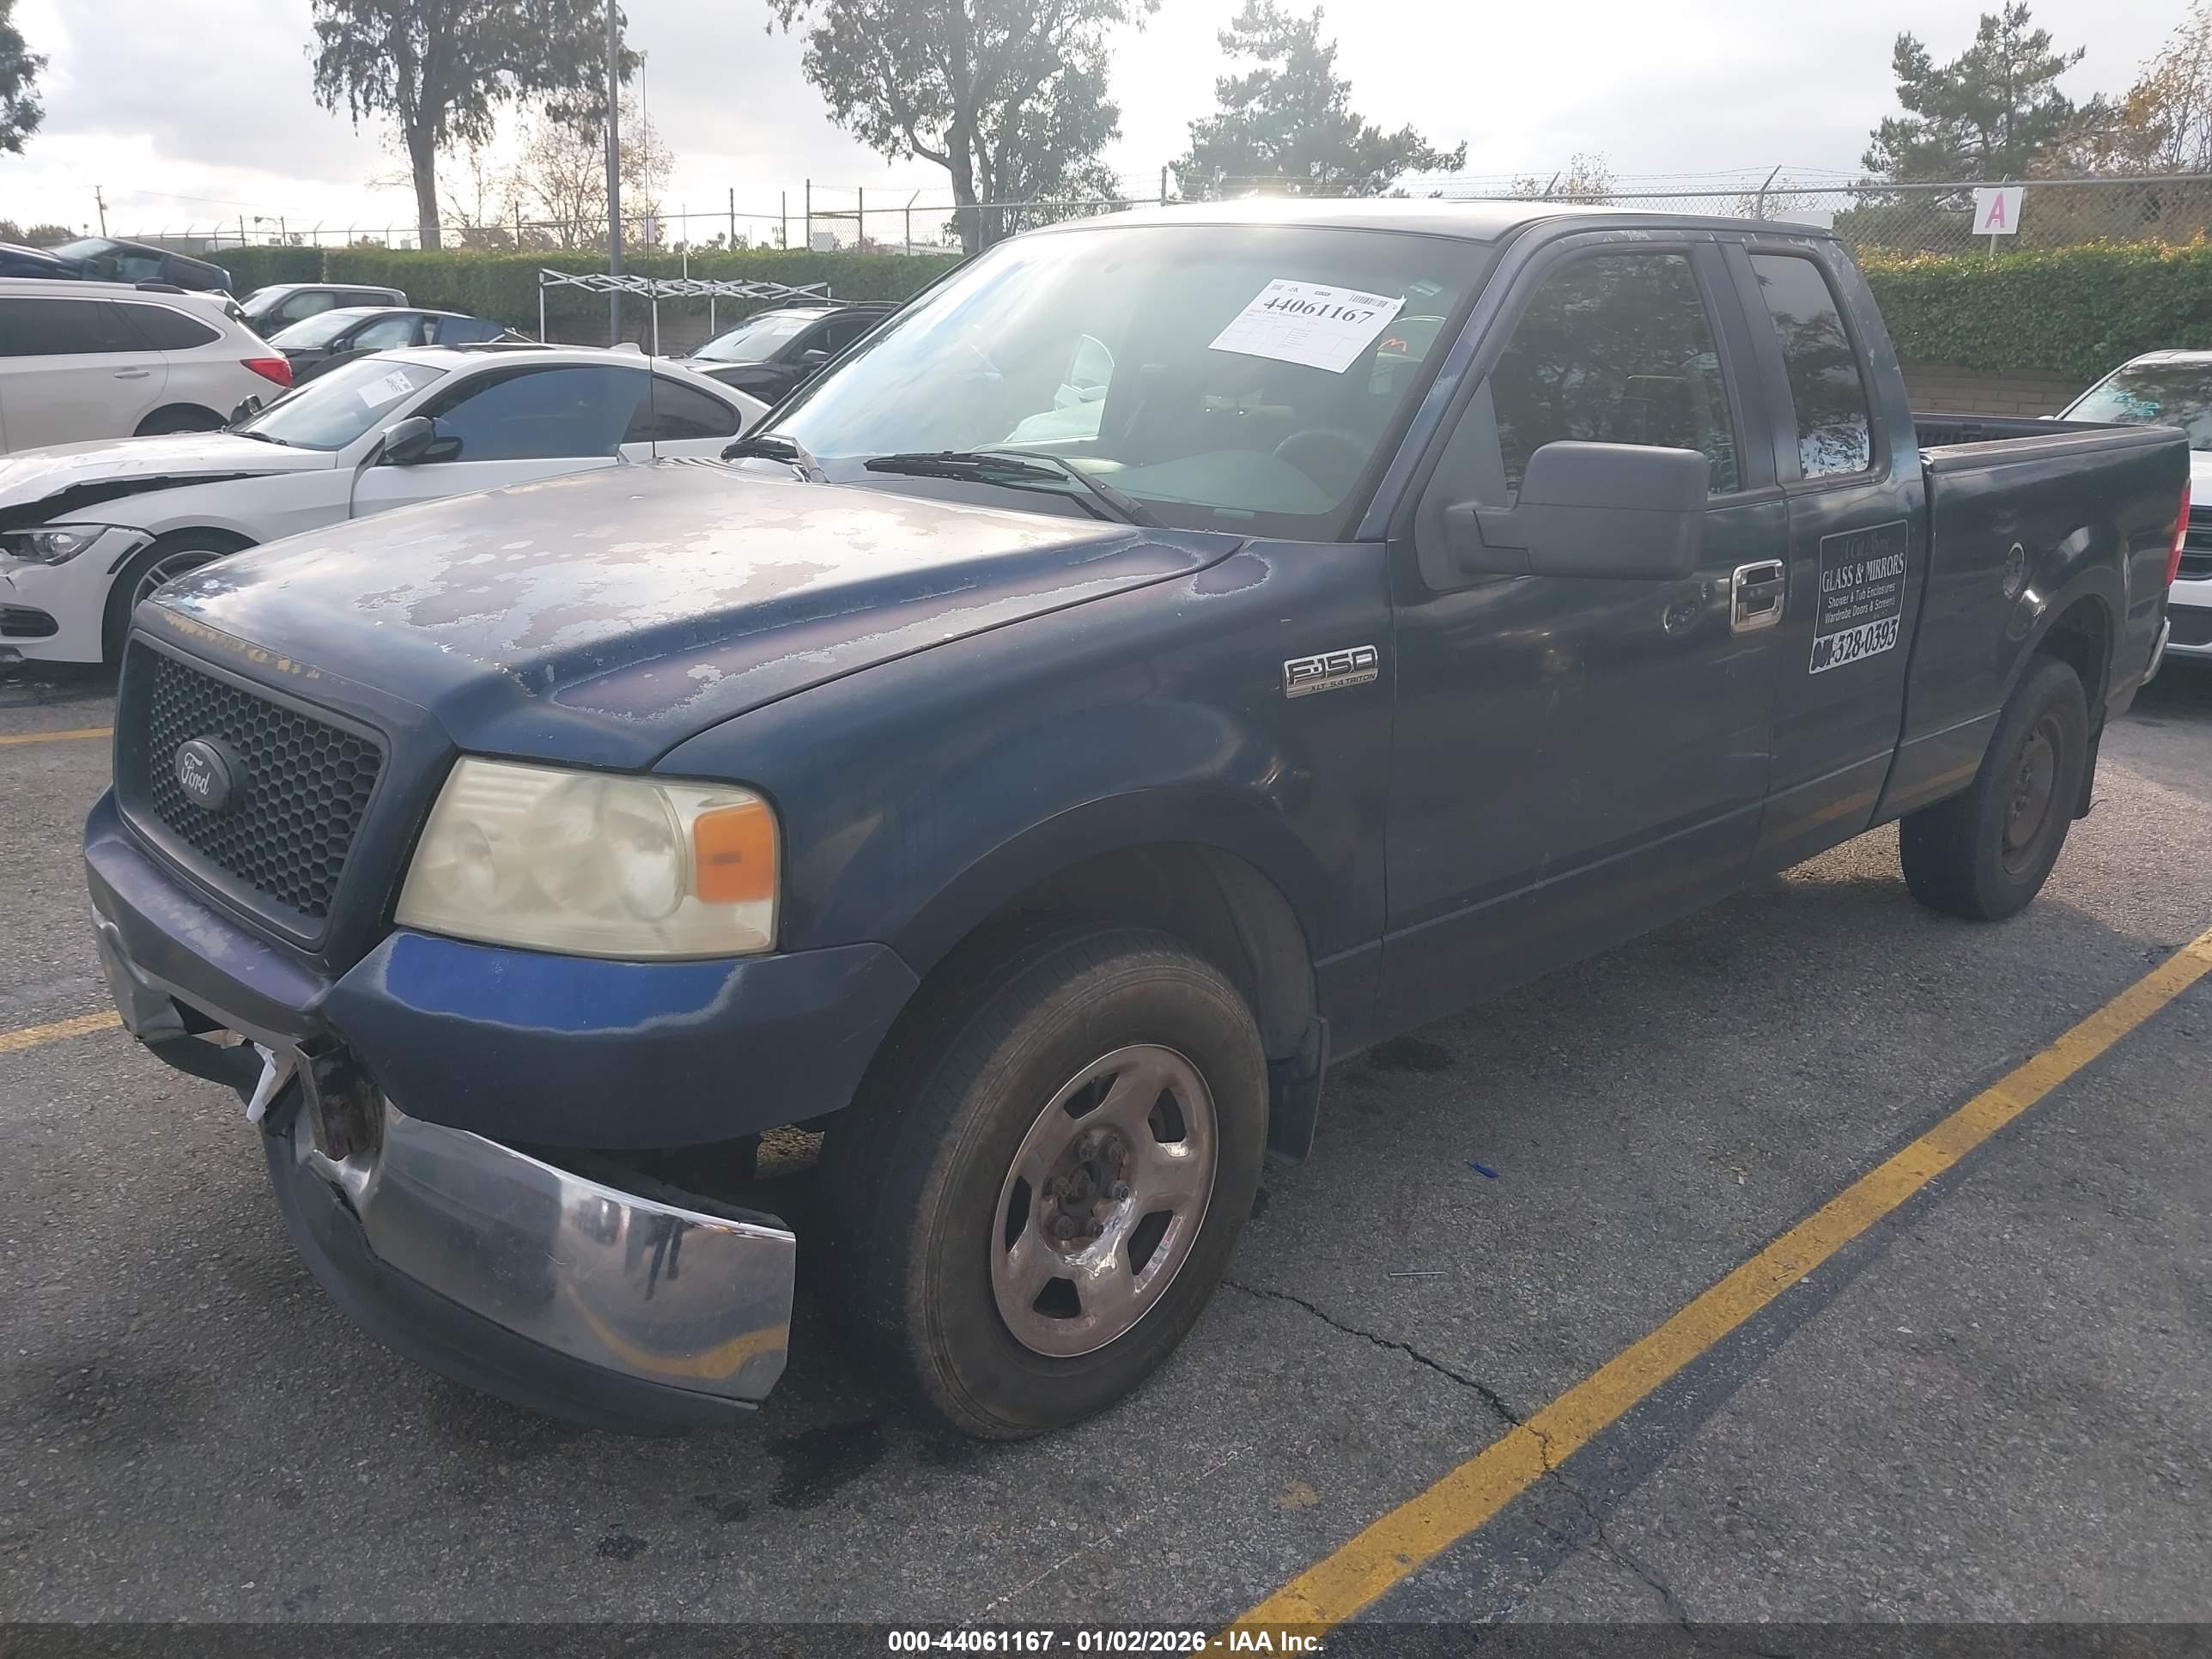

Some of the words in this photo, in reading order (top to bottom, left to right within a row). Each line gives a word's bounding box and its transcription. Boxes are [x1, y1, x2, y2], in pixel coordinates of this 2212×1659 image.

[1984, 191, 2006, 228] A
[1263, 296, 1376, 325] 44061167
[1822, 564, 1854, 592] GLASS
[1856, 562, 1864, 585] &
[1865, 552, 1904, 583] MIRRORS
[1825, 608, 1852, 625] Wardrobe
[1852, 604, 1869, 617] Doors
[1869, 600, 1874, 612] &
[1875, 597, 1895, 611] Screens
[1827, 595, 1850, 609] Shower
[1850, 591, 1855, 603] &
[1856, 588, 1866, 602] Tub
[1867, 582, 1896, 599] Enclosures
[1287, 647, 1376, 686] F-150
[1346, 672, 1376, 685] TRITON
[181, 752, 211, 796] Ford
